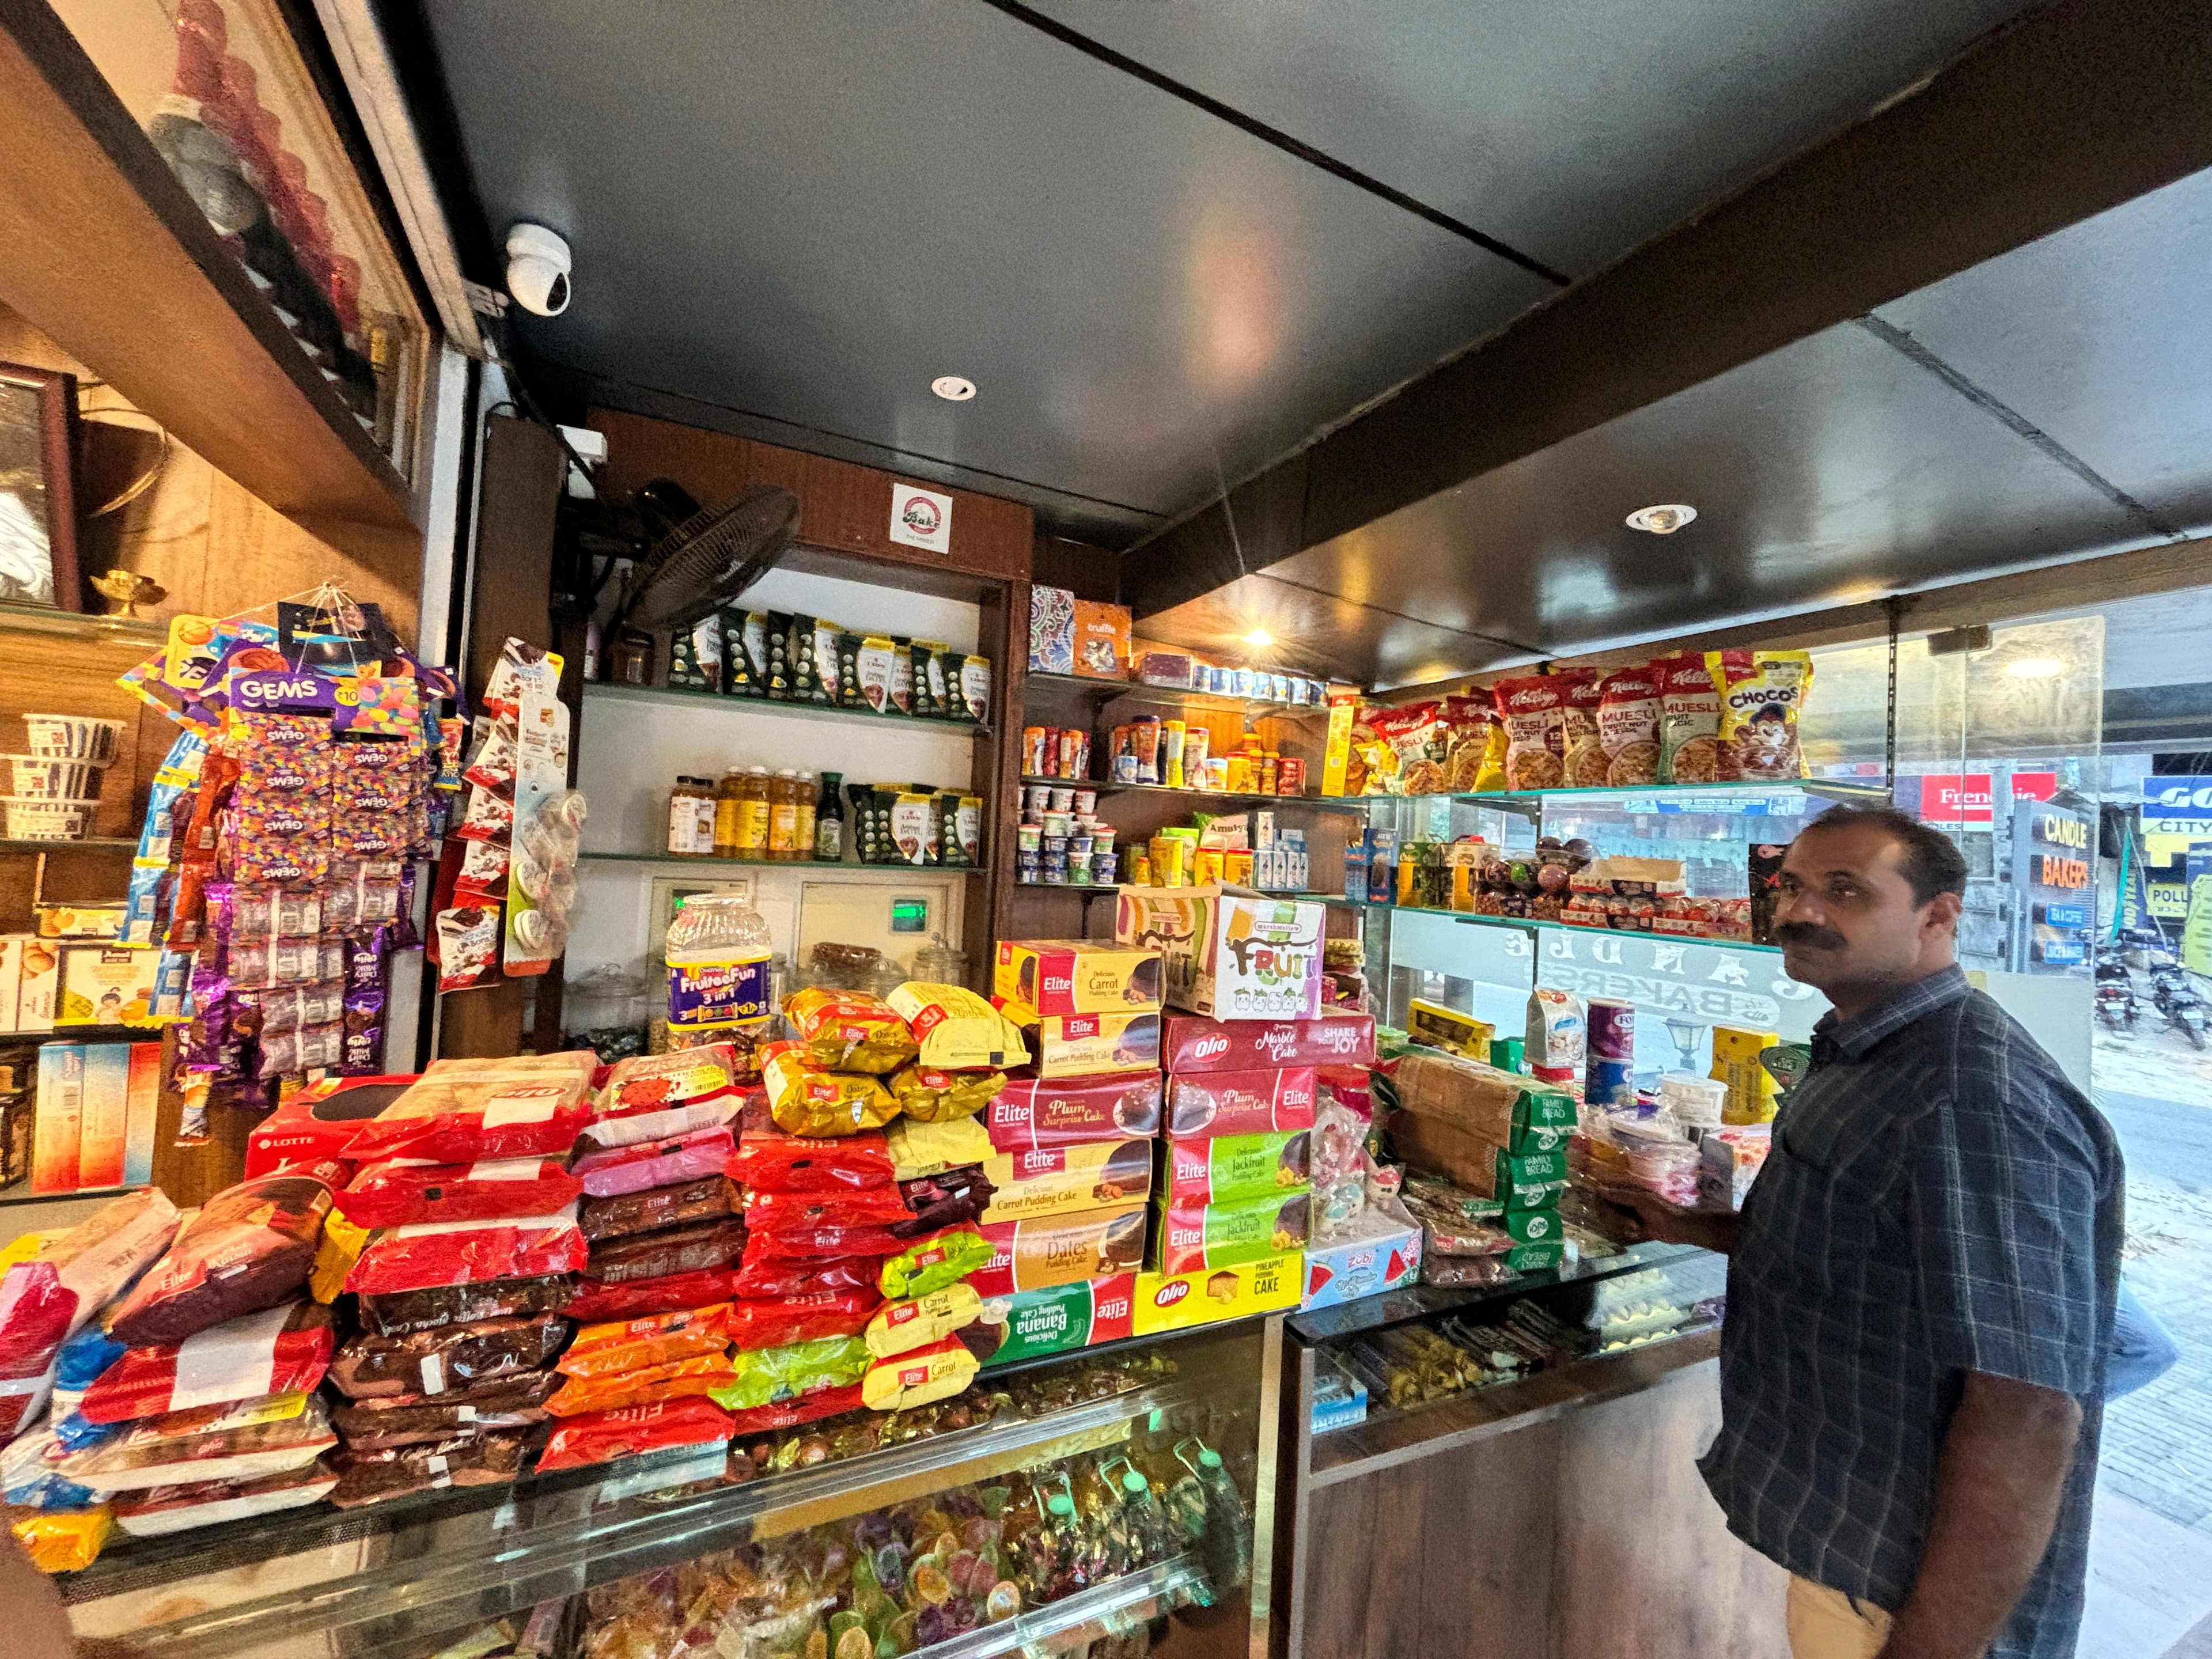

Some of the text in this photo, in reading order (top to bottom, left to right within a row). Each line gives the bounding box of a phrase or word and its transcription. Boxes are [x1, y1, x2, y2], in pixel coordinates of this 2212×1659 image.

[240, 680, 318, 700] GEMS
[1729, 686, 1798, 709] CHOCOS
[1601, 709, 1658, 723] MUESLI
[267, 729, 305, 741] GEMS
[354, 752, 388, 764] GEMS
[266, 776, 305, 787] GEMS
[354, 797, 388, 807] GEMS
[264, 820, 303, 832] GEMS
[2044, 813, 2087, 849] CANDLE
[2159, 821, 2212, 833] CITY
[353, 840, 387, 851] GEMS
[262, 866, 301, 879] GEMS
[1229, 937, 1318, 986] FRUIT
[1043, 976, 1072, 991] Elite
[1088, 978, 1119, 990] Carrot
[703, 987, 735, 1005] 3 in 1
[679, 1010, 688, 1021] 3
[846, 1028, 865, 1039] Elite
[1070, 1019, 1094, 1034] Elite
[1324, 1027, 1357, 1037] SHARE
[1255, 1031, 1296, 1051] Marble
[1331, 1037, 1361, 1054] JOY
[1048, 1051, 1112, 1065] Carrot Pudding Cake
[1272, 1044, 1298, 1062] Cake
[925, 1074, 944, 1085] Elite
[813, 1086, 832, 1097] Elite
[1224, 1089, 1256, 1104] Plum
[1282, 1089, 1310, 1107] Elite
[1048, 1099, 1085, 1115] Plum
[1542, 1098, 1564, 1108] FAMILY
[994, 1104, 1030, 1123] Elite
[1043, 1114, 1083, 1130] Surprise
[272, 1136, 316, 1147] LOTTE
[1024, 1152, 1056, 1169] Elite
[1232, 1157, 1266, 1172] Jackfruit
[1524, 1155, 1552, 1165] FAMILY
[1176, 1164, 1207, 1181] Elite
[1525, 1164, 1554, 1176] BREAD
[910, 1180, 929, 1192] Elite
[997, 1191, 1078, 1211] Carrot Pudding Cake
[1226, 1221, 1261, 1236] Jackfruit
[814, 1236, 840, 1247] Elite
[1170, 1228, 1201, 1247] Elite
[1046, 1240, 1088, 1259] Dates
[921, 1253, 939, 1265] Elite
[1255, 1259, 1285, 1272] PINEAPPLE
[1254, 1277, 1279, 1296] CAKE
[923, 1294, 949, 1309] Carrot
[893, 1308, 914, 1320] Elite
[1020, 1304, 1066, 1319] Pudding Cake
[1096, 1300, 1129, 1319] Elite
[631, 1321, 656, 1333] Elite
[1016, 1315, 1068, 1335] Banana
[1024, 1330, 1058, 1344] Delicious
[930, 1361, 957, 1376] Carrot
[904, 1372, 924, 1383] Elite
[603, 1402, 664, 1423] Elite
